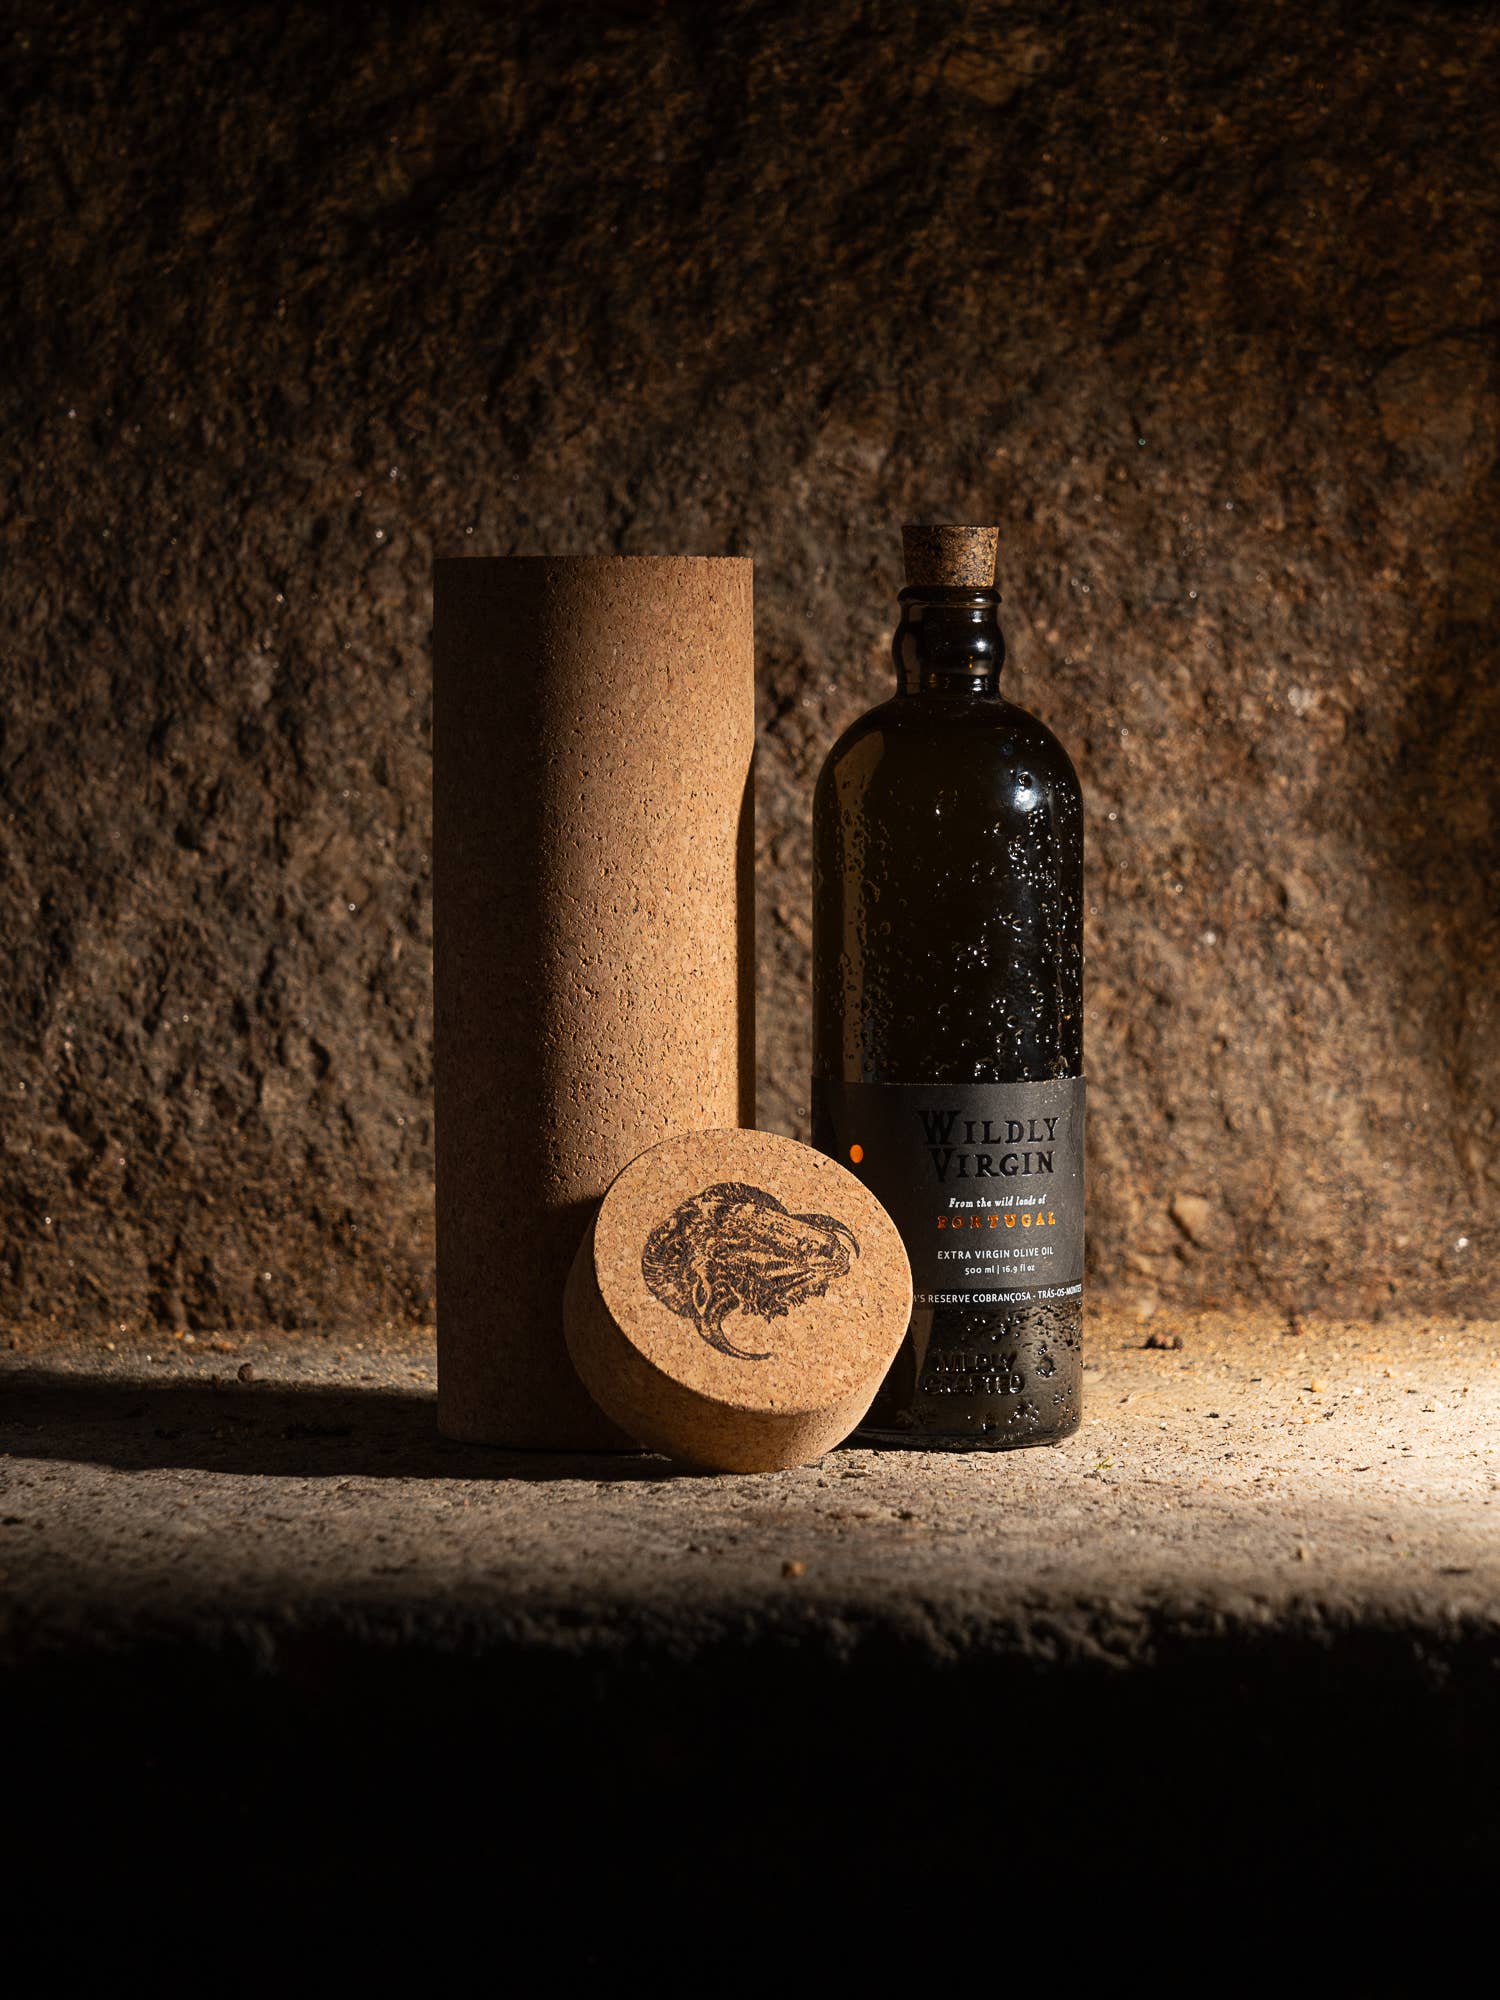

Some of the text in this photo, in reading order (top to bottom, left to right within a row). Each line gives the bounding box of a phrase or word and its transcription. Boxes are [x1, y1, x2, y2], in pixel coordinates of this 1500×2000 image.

[918, 1110, 1059, 1146] WILDLY
[929, 1148, 1054, 1182] VIRGIN
[949, 1197, 974, 1208] From
[976, 1197, 992, 1208] the
[995, 1195, 1014, 1207] wild
[1038, 1194, 1047, 1205] of
[936, 1211, 1056, 1230] PORTUGAL
[937, 1246, 1054, 1260] EXTRA VIRGIN OLIVE OIL
[964, 1266, 982, 1276] 500
[985, 1265, 995, 1274] ml
[1002, 1265, 1018, 1274] 16.9
[1019, 1263, 1026, 1273] fl
[1026, 1265, 1036, 1273] oz
[928, 1293, 970, 1303] RESERVE
[972, 1291, 1031, 1304] COBRANÇOSA
